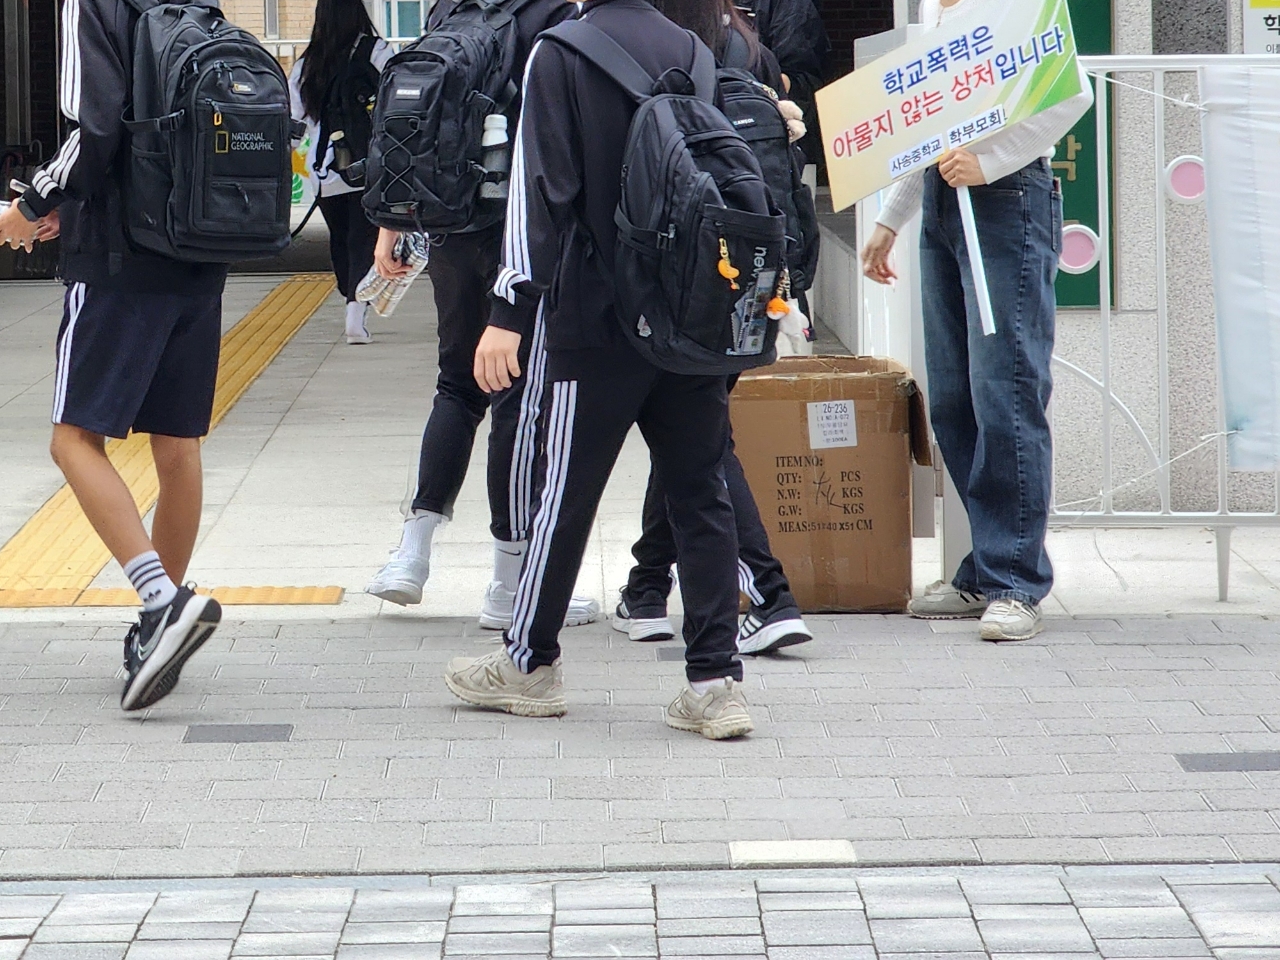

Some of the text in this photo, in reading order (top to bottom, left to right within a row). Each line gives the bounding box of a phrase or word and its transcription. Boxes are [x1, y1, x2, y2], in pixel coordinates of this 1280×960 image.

[883, 25, 994, 95] 학교폭력은
[833, 26, 1065, 158] 아물지 않는 상처입니다
[231, 132, 266, 141] NATIONAL
[891, 108, 1009, 171] 사송중학교 학부모회!
[230, 141, 274, 151] GEOGRAPHIC
[776, 470, 862, 486] QTY: PCS
[777, 486, 864, 500] N.W: KGS
[778, 502, 865, 517] G.W: KGS
[856, 519, 873, 531] CM
